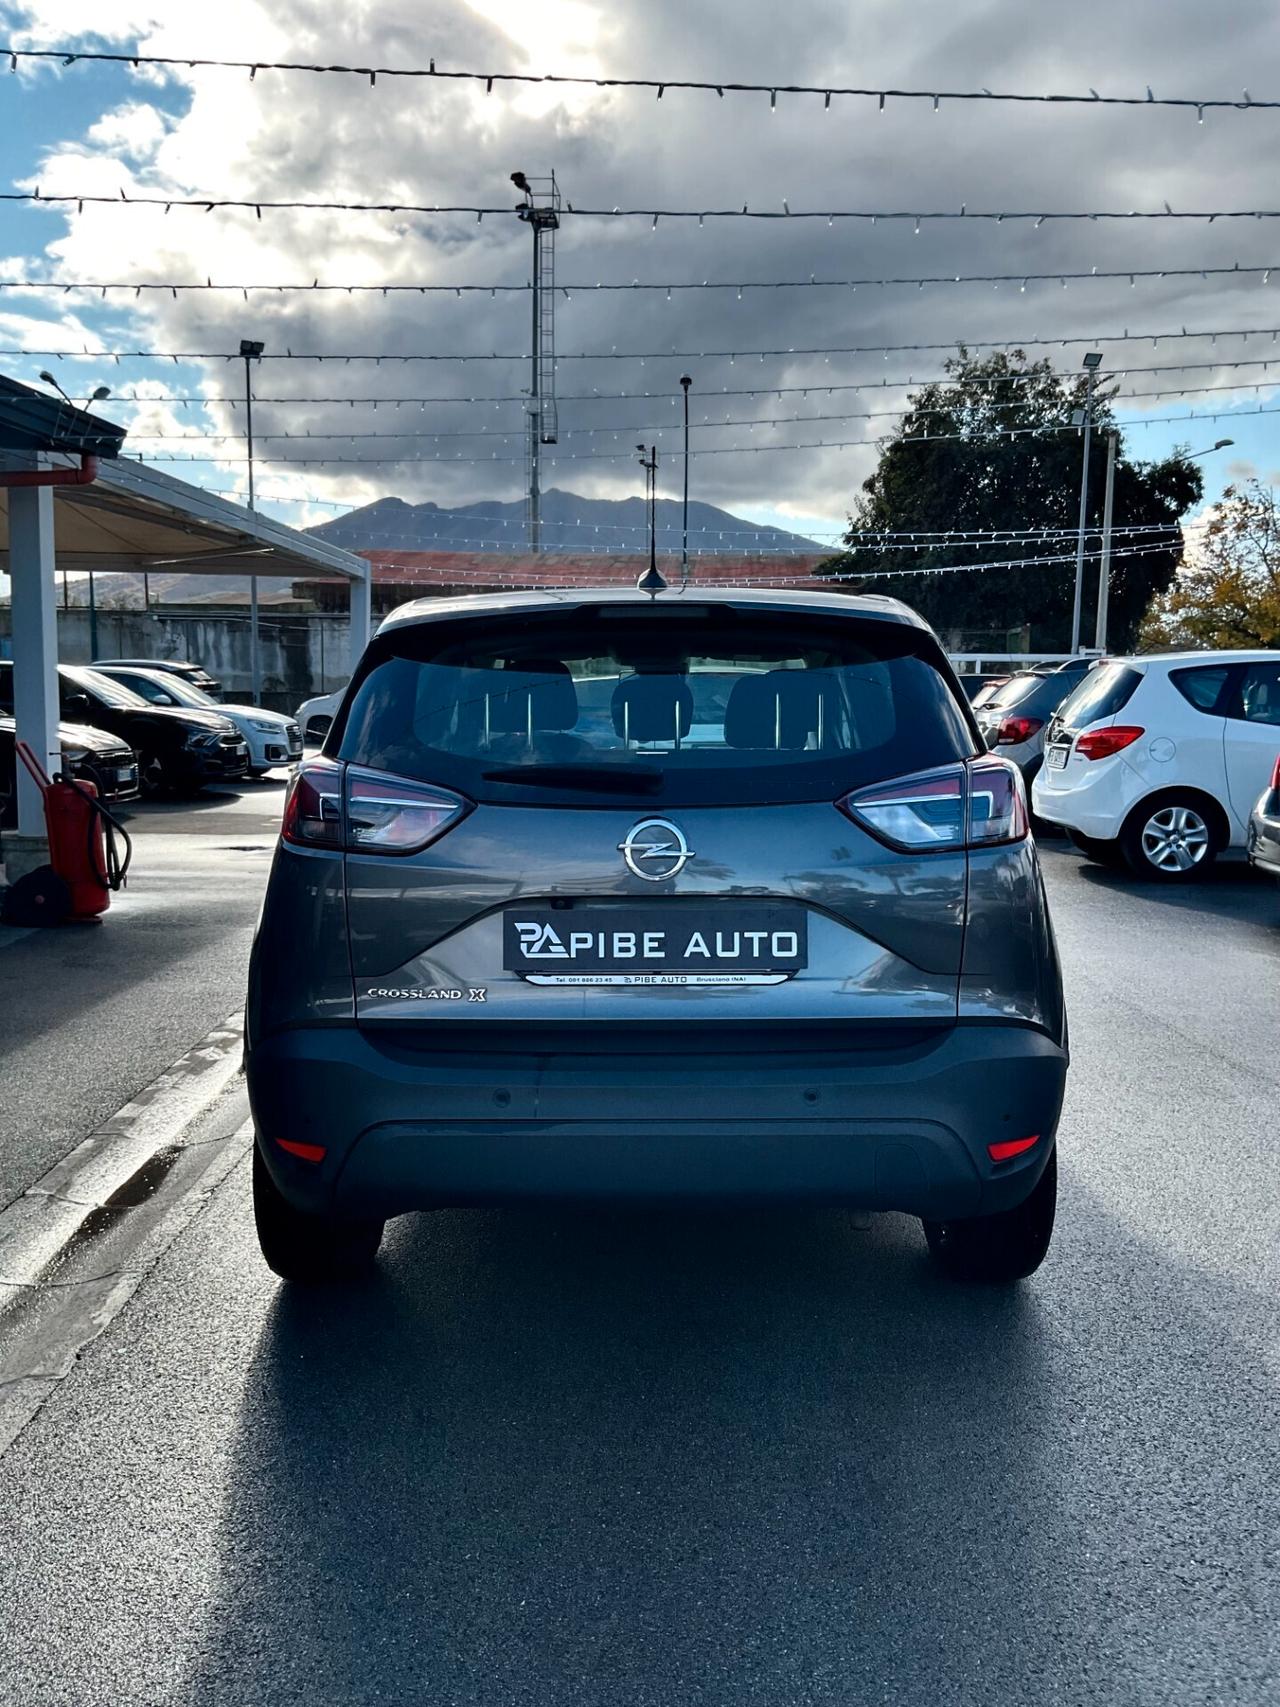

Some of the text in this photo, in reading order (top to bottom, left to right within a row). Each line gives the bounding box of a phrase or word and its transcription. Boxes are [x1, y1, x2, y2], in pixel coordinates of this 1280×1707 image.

[570, 932, 665, 958] PIBE
[683, 931, 798, 958] AUTO
[367, 988, 486, 1002] CROSSLAND X
